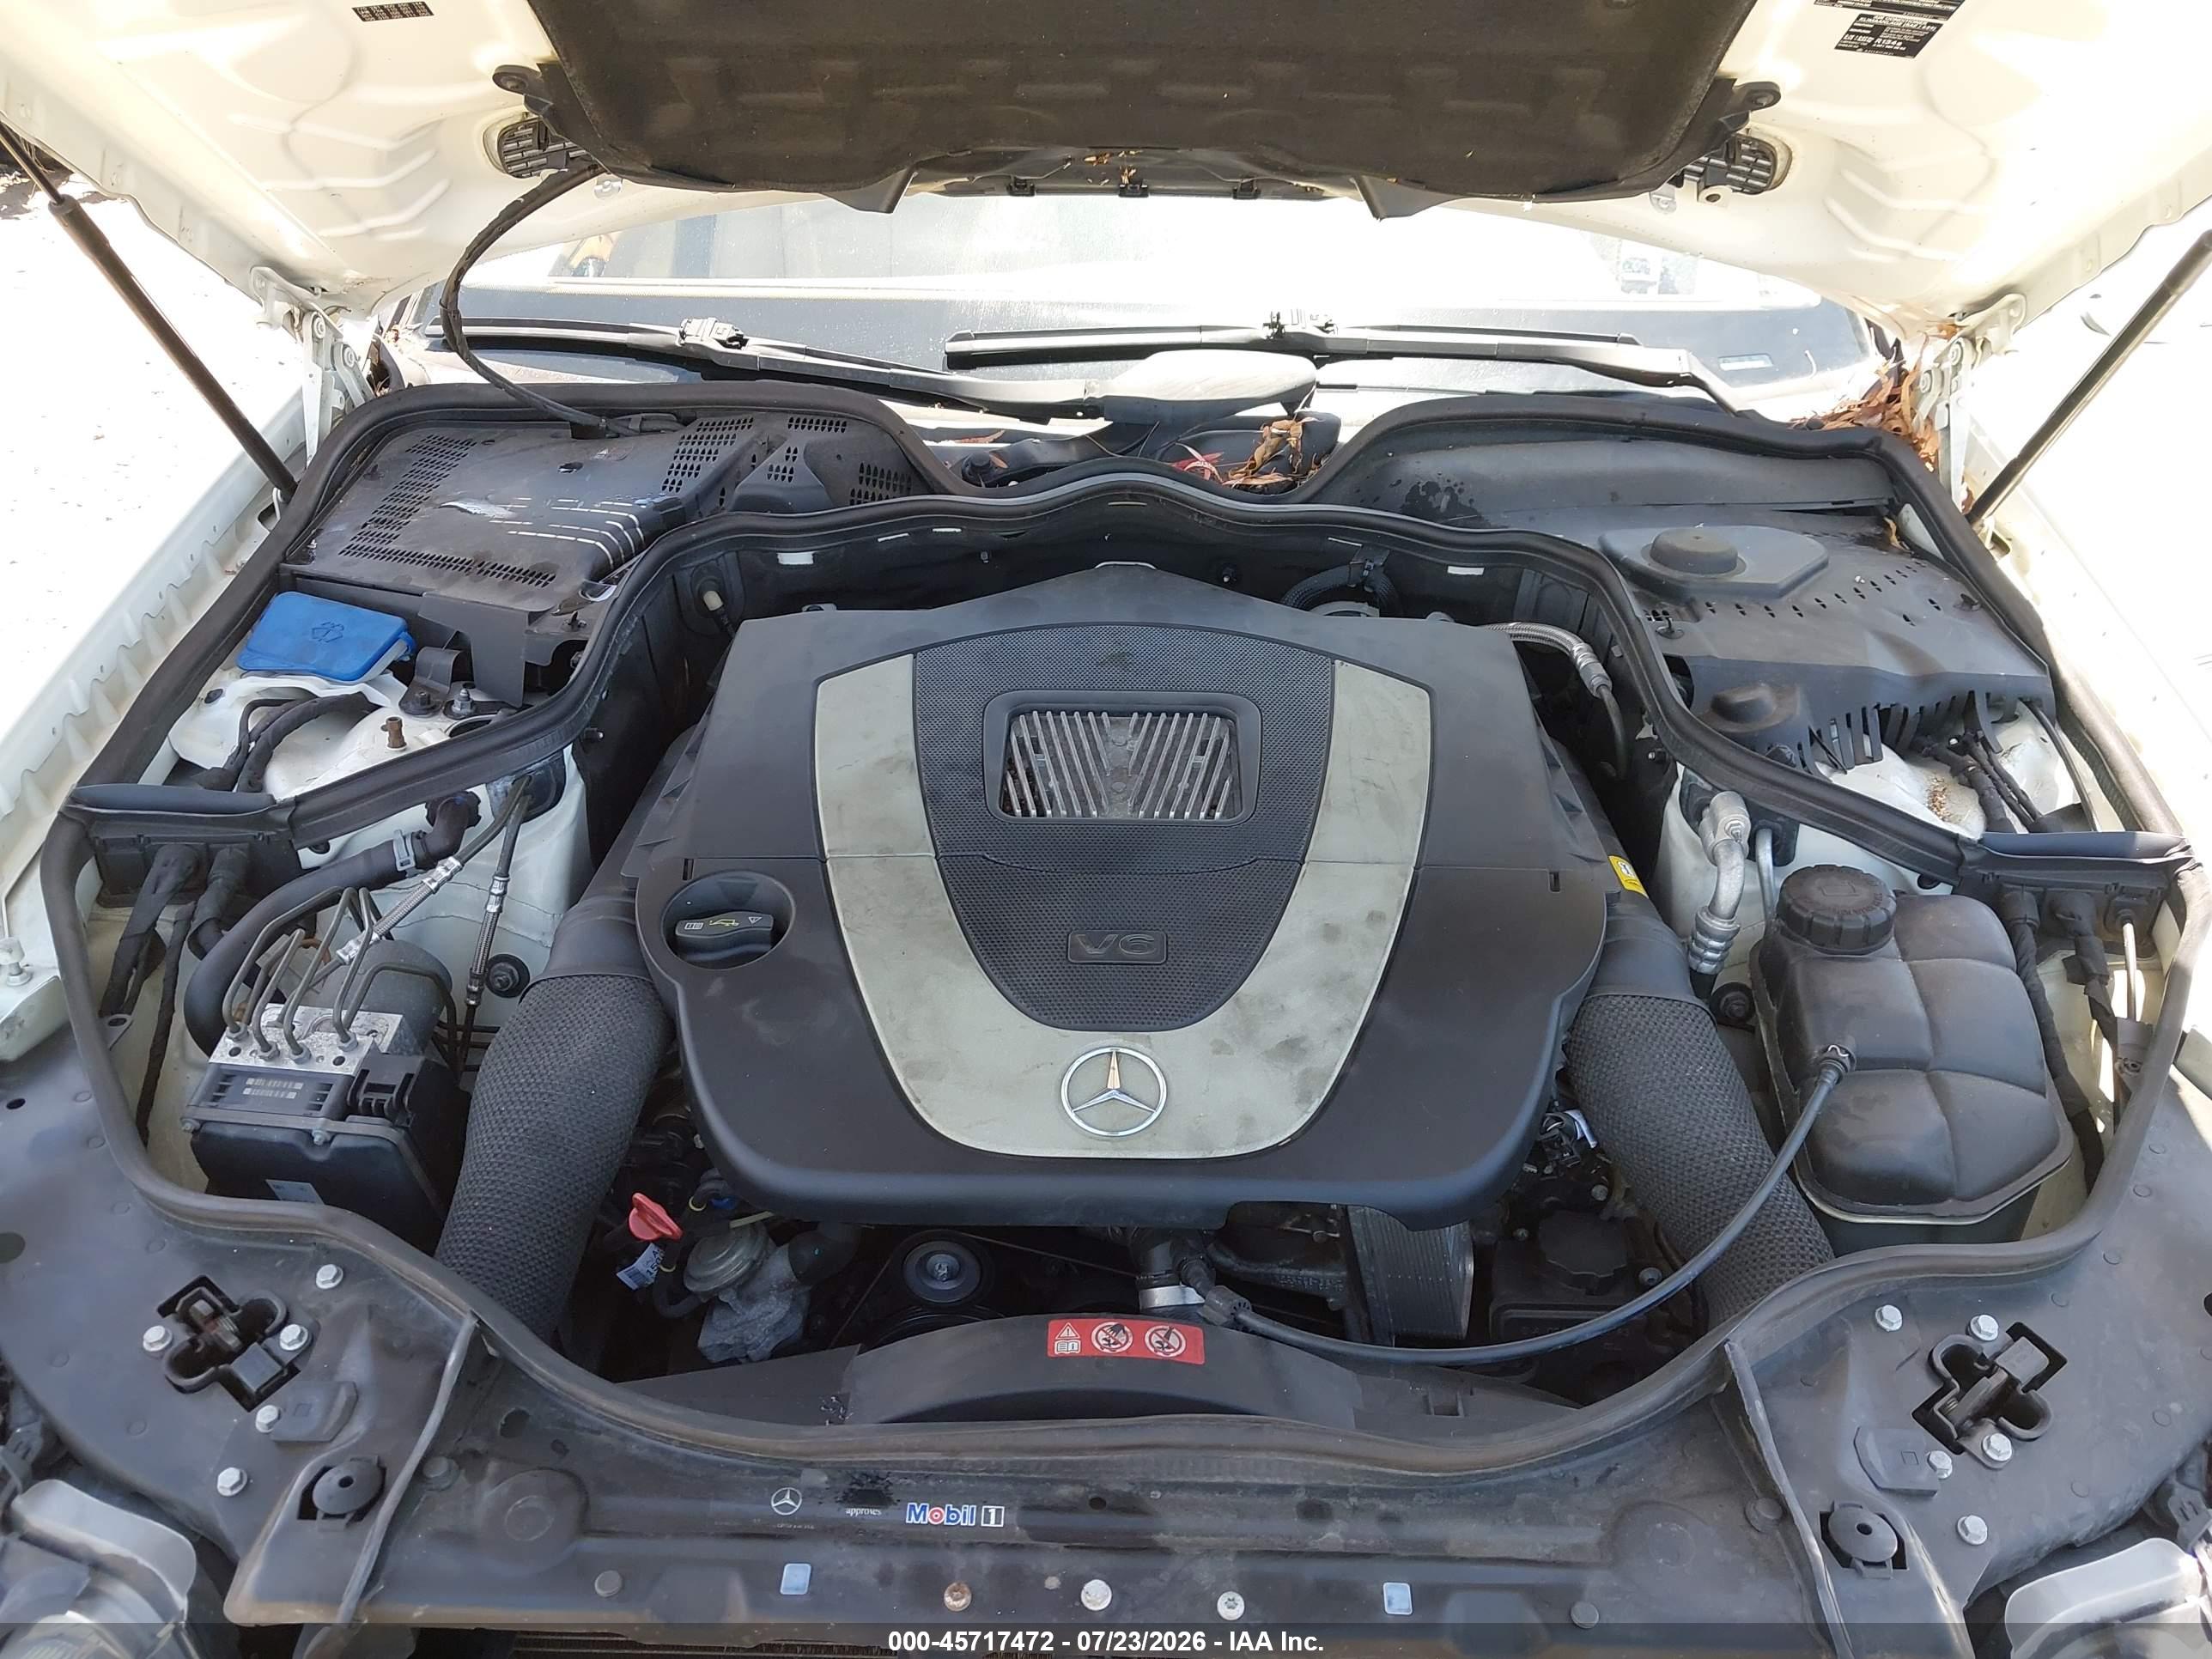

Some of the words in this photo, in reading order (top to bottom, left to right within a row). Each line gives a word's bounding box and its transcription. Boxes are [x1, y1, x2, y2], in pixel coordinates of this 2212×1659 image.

[1075, 933, 1158, 955] V6
[845, 1507, 882, 1516] approves
[906, 1503, 977, 1526] Mobil
